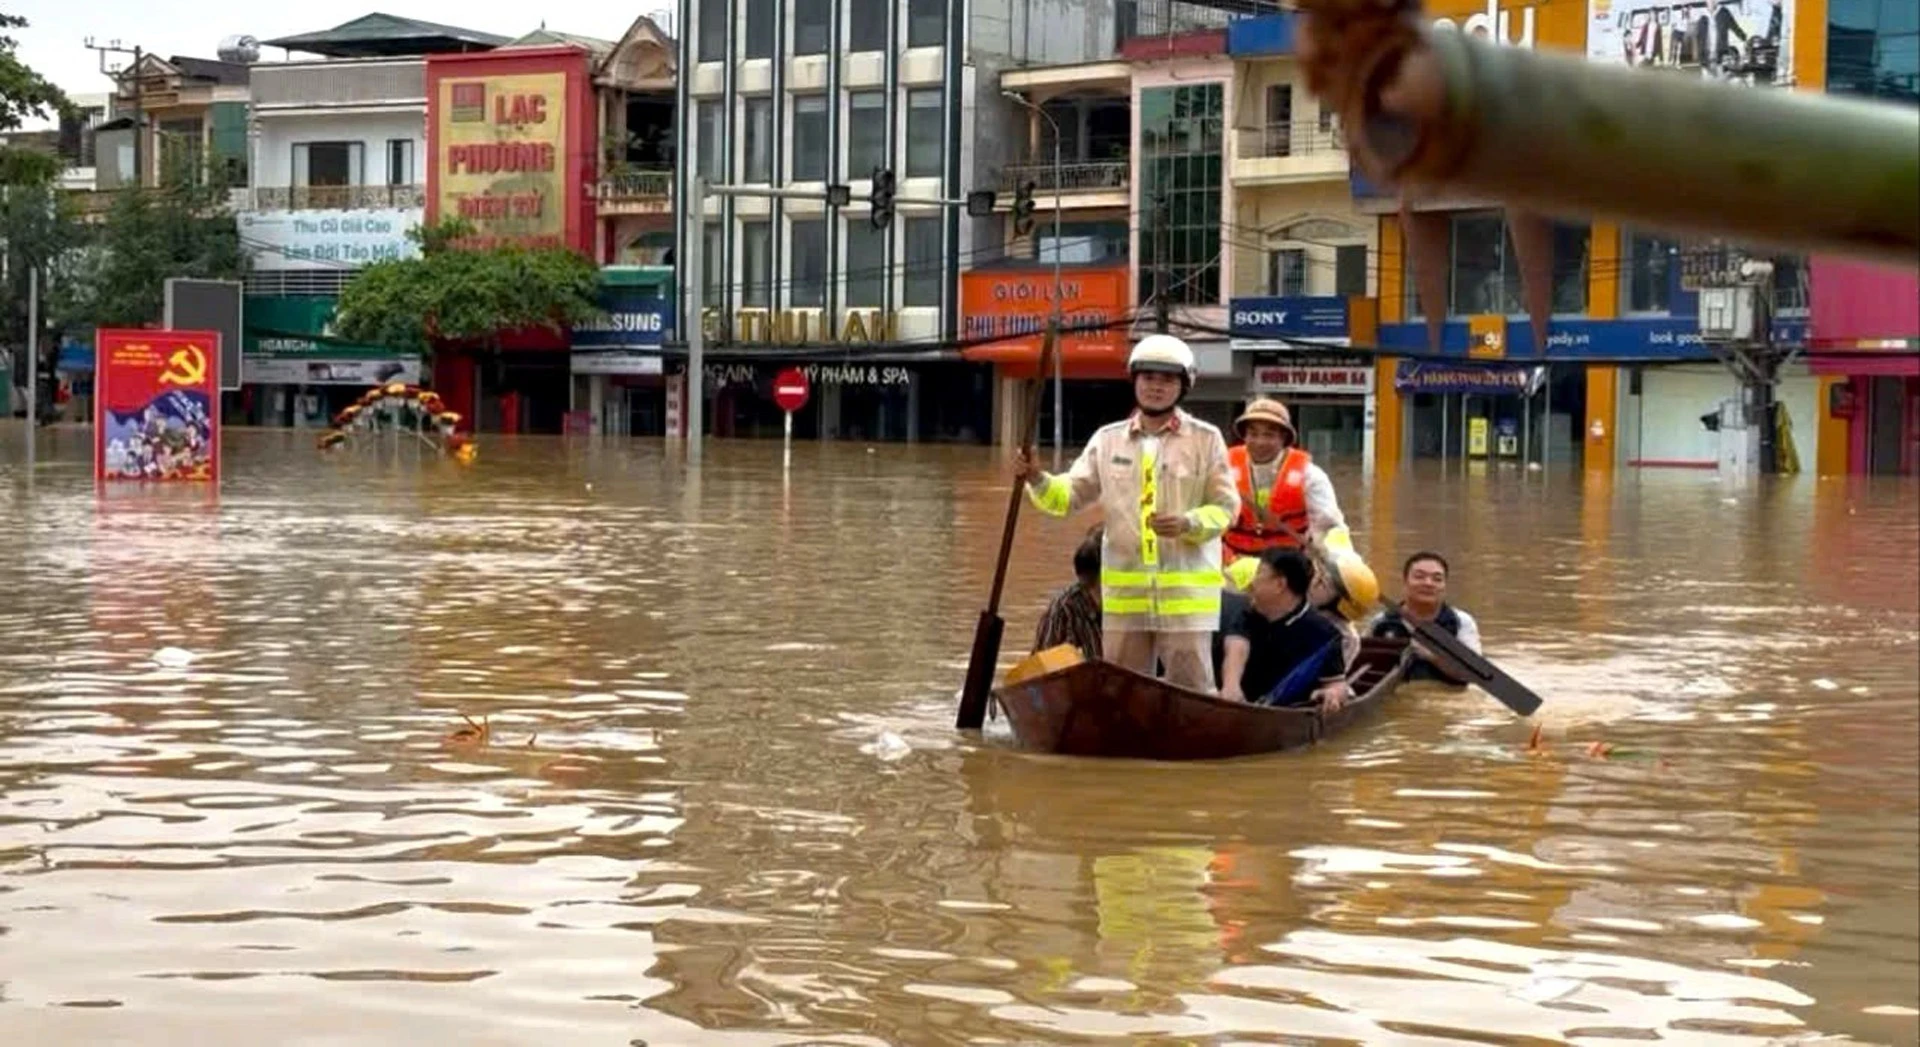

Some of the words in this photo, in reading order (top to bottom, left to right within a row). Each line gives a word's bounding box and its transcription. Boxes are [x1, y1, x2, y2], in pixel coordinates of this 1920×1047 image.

[494, 93, 547, 131] LẠC
[293, 219, 318, 233] Thu
[320, 217, 338, 233] Cũ
[341, 218, 363, 233] Giá
[365, 219, 392, 233] Cao
[1234, 311, 1288, 325] SONY
[1547, 333, 1589, 348] yody.vn
[1650, 332, 1673, 343] look
[867, 367, 878, 384] &
[882, 367, 910, 384] SPA
